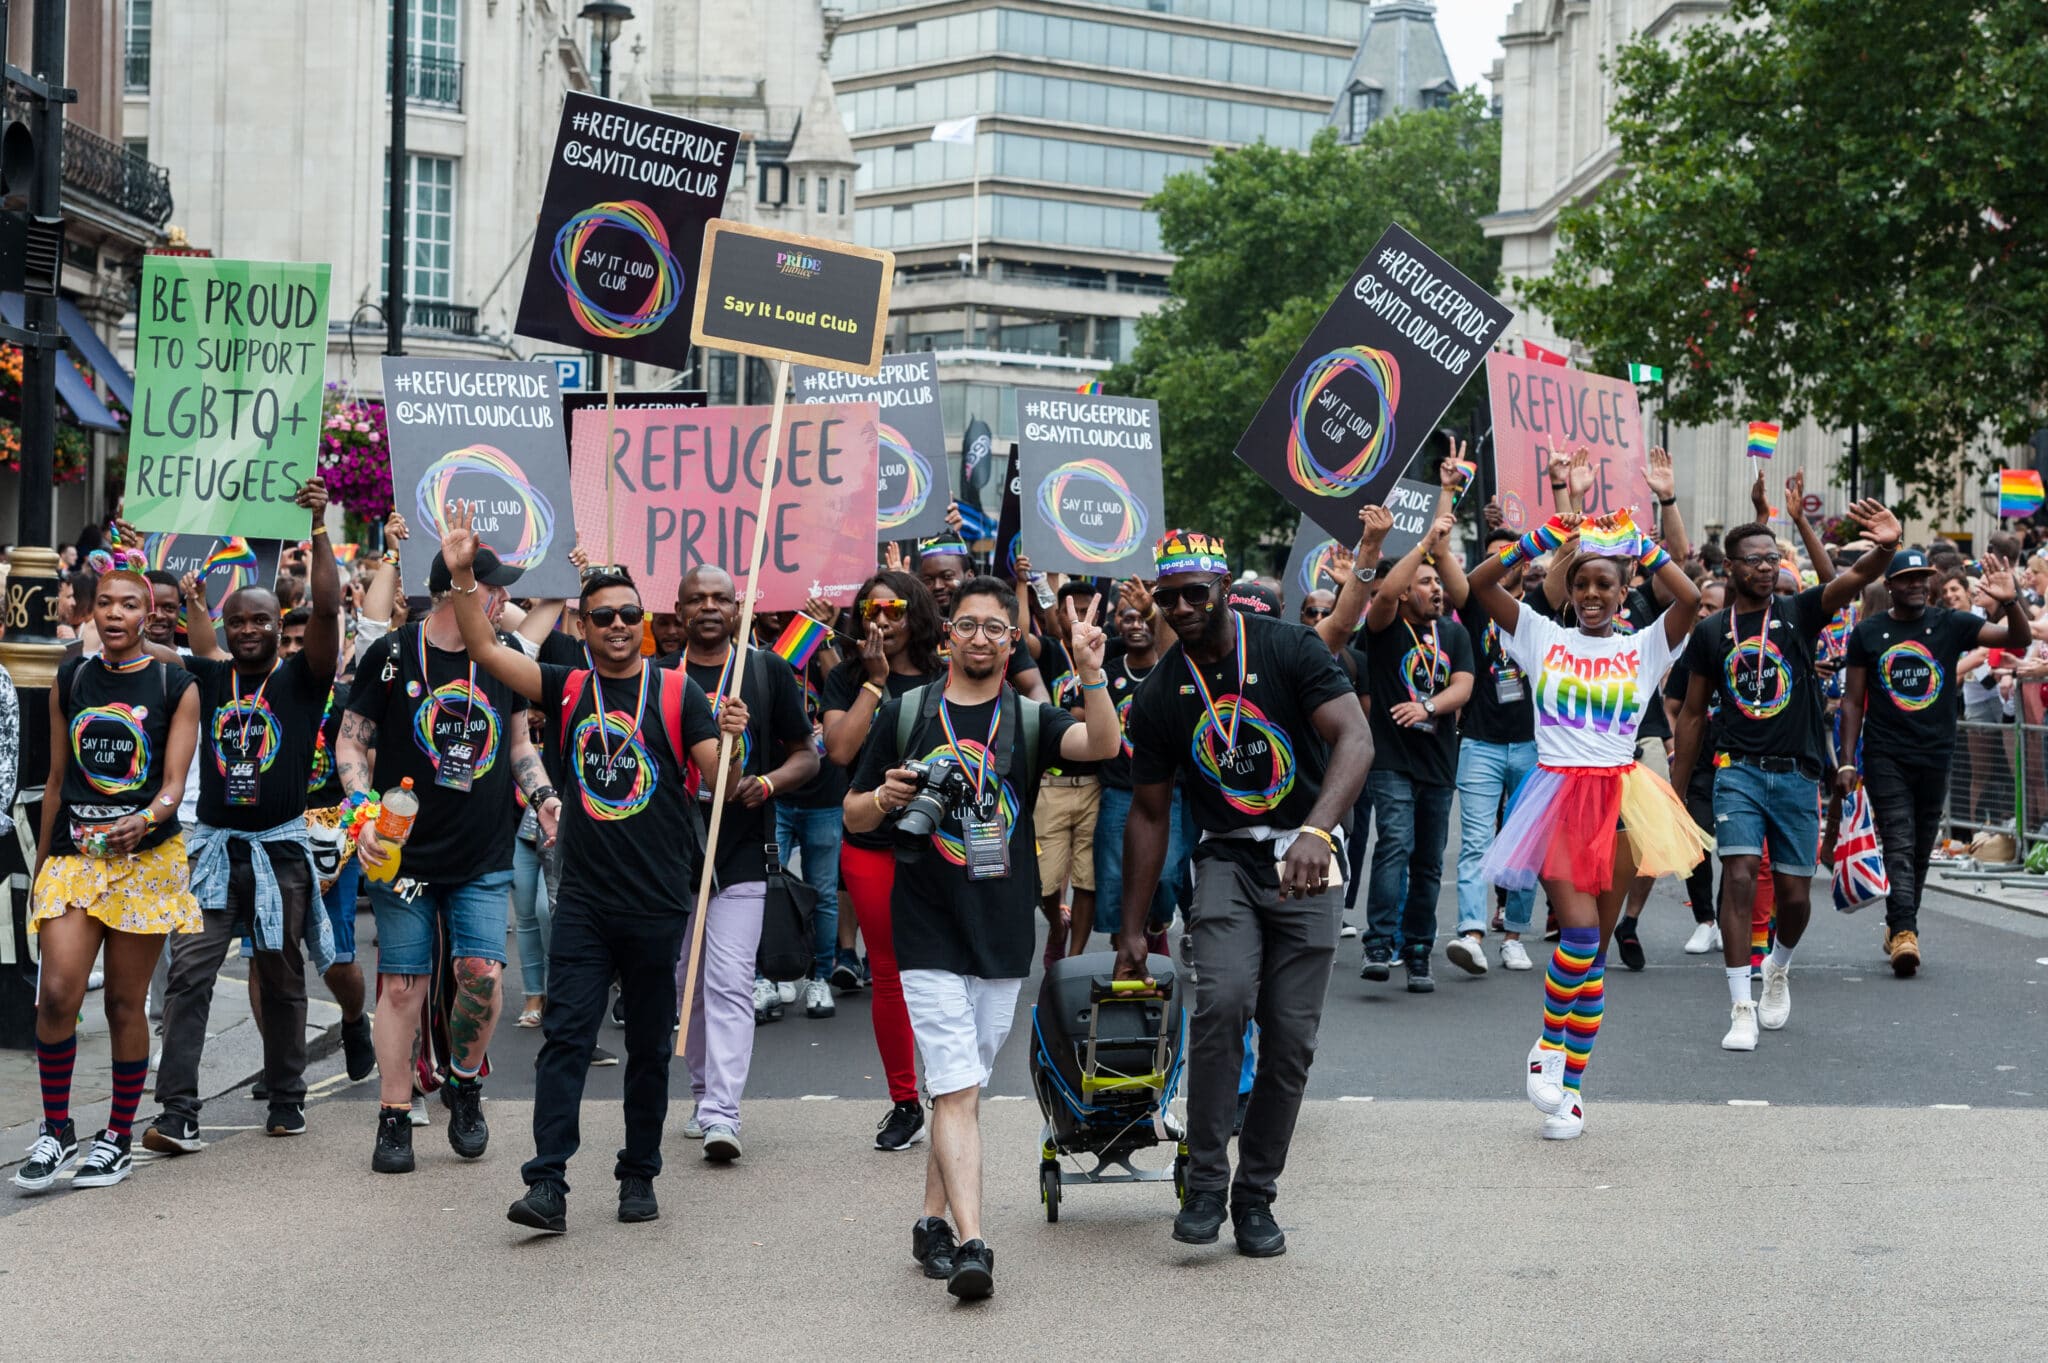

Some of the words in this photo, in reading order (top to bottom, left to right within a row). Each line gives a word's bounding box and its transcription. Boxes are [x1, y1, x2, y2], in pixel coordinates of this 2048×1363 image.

[572, 111, 728, 167] #REFUGEEPRIDE
[563, 140, 719, 198] @SAYITLOUDCLUB
[582, 249, 607, 269] SAY
[608, 255, 623, 272] IT
[624, 260, 654, 279] LOUD
[776, 251, 822, 271] PRIDE
[598, 271, 627, 291] CLUB
[152, 274, 190, 323] BE
[205, 278, 317, 329] PROUD
[1377, 247, 1497, 345] #REFUGEEPRIDE
[723, 295, 755, 317] Say
[758, 301, 771, 317] It
[775, 304, 816, 326] Loud
[820, 314, 858, 334] Club
[1353, 274, 1471, 376] @SAYITLOUDCLUB
[148, 336, 184, 369] TO
[195, 337, 316, 375] SUPPORT
[394, 371, 550, 399] #REFUGEEPRIDE
[558, 363, 576, 385] P
[143, 382, 308, 450] LGBTQ+
[396, 401, 554, 428] @SAYITLOUDCLUB
[1025, 401, 1151, 427] #REFUGEEPRIDE
[1318, 389, 1341, 411] SAY
[1335, 402, 1352, 420] IT
[1346, 412, 1373, 439] LOUD
[1507, 371, 1629, 449] REFUGEE
[1025, 423, 1153, 450] @SAYITLOUDCLUB
[1321, 417, 1346, 444] CLUB
[604, 418, 845, 494] REFUGEE
[137, 454, 302, 503] REFUGEES
[880, 463, 906, 477] LOUD
[447, 499, 470, 515] SY
[474, 500, 486, 514] IT
[491, 500, 521, 516] LOUD
[1062, 498, 1081, 511] SAY
[1083, 500, 1094, 512] IT
[1097, 501, 1122, 514] LOUD
[471, 516, 500, 531] CLUB
[1080, 514, 1103, 526] CLUB
[646, 502, 803, 576] PRIDE
[166, 556, 187, 572] SAY
[189, 558, 202, 571] IT
[824, 583, 864, 592] COMMUNIT
[1536, 671, 1641, 736] LOVE
[250, 724, 264, 736] OUD
[436, 722, 452, 735] SAY
[454, 722, 463, 733] IT
[82, 738, 98, 750] SAY
[100, 739, 109, 750] IT
[111, 740, 134, 752] LOUD
[94, 751, 116, 763] CLUB
[1248, 740, 1267, 756] OUD
[585, 752, 600, 766] SAY
[602, 754, 611, 766] IT
[614, 756, 636, 769] LOUD
